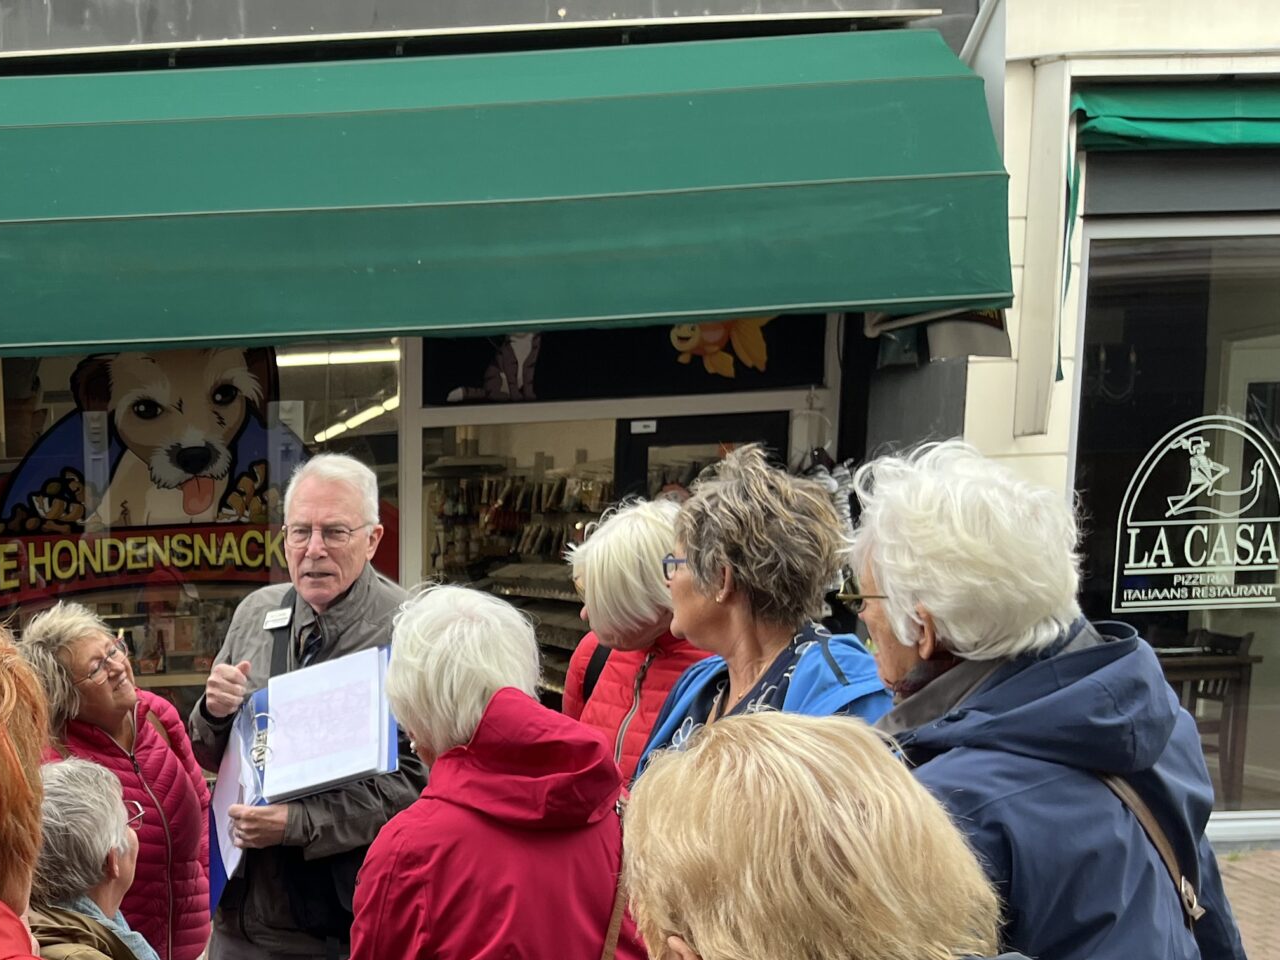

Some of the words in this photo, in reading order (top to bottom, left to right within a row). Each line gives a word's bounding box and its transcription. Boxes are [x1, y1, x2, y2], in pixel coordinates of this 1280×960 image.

[1124, 526, 1174, 568] LA
[1184, 523, 1279, 567] CASA
[1173, 573, 1229, 586] PIZZERIA
[1123, 586, 1189, 600] ITALIAANS
[1192, 585, 1274, 599] RESTAURANT
